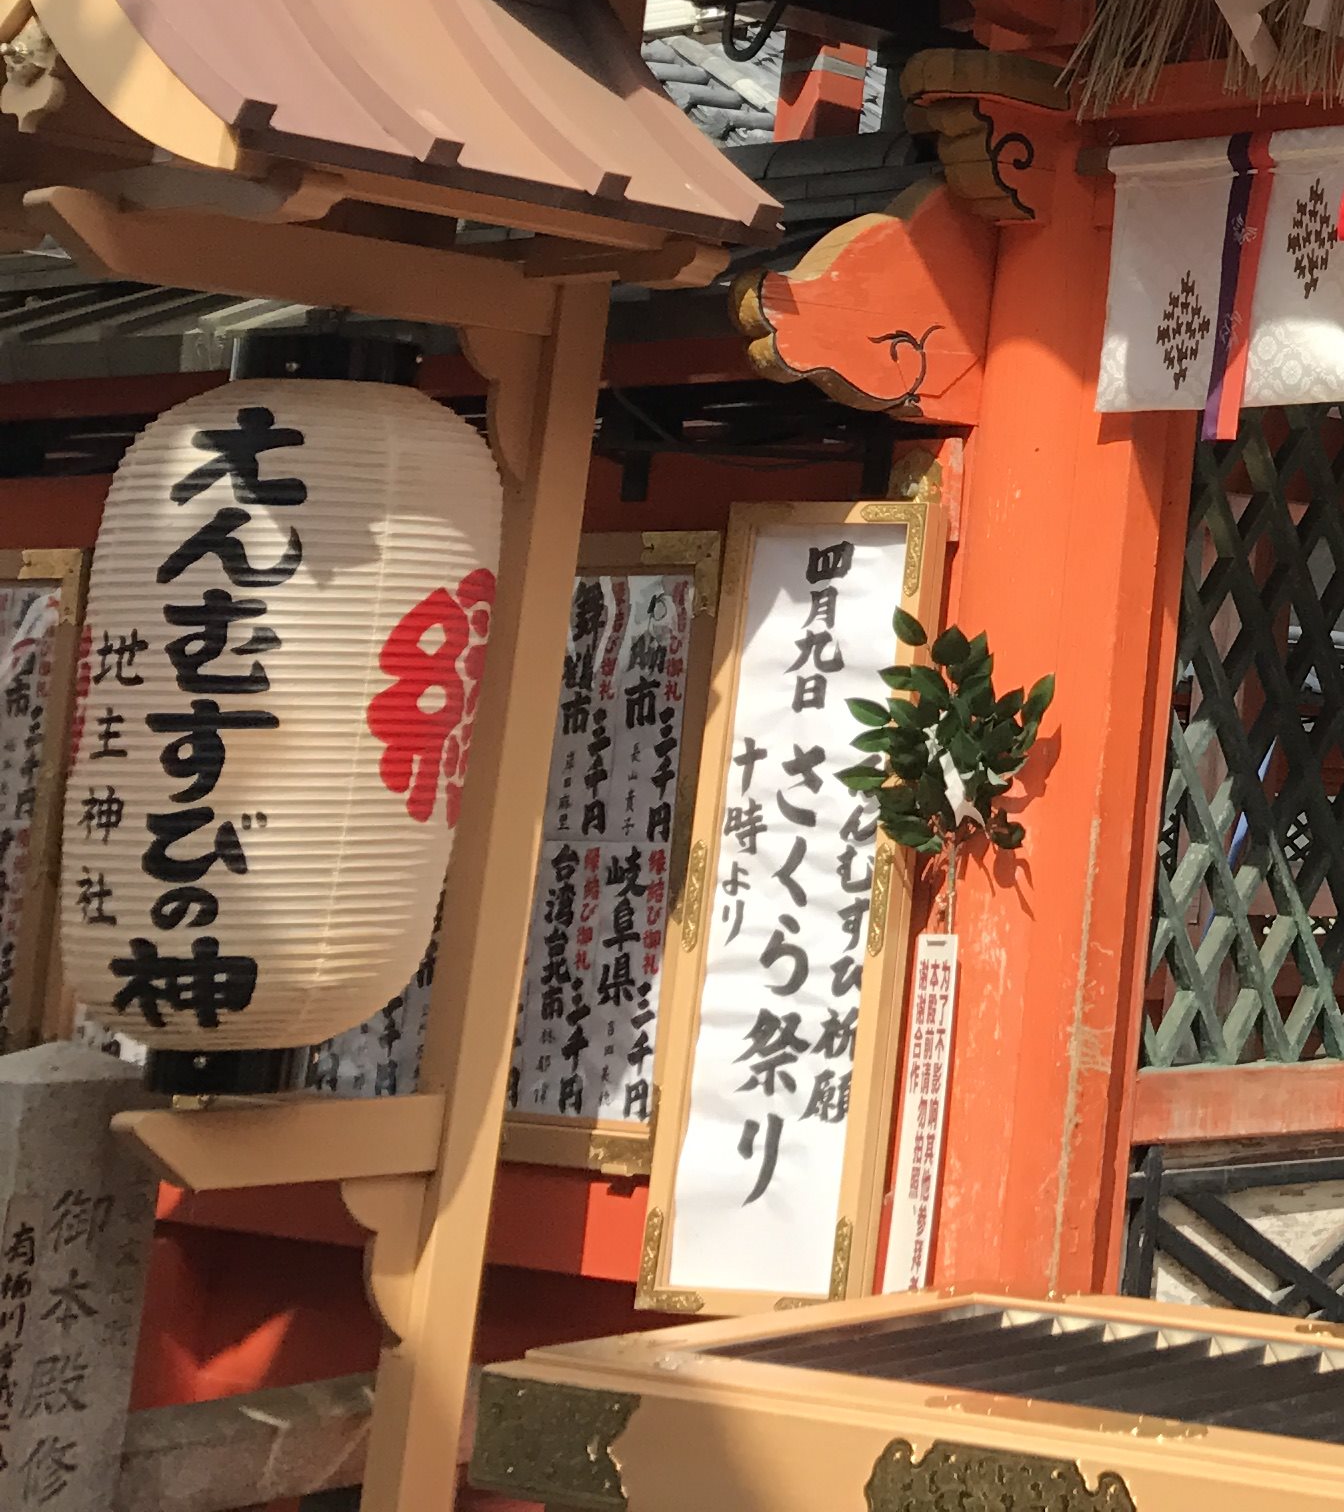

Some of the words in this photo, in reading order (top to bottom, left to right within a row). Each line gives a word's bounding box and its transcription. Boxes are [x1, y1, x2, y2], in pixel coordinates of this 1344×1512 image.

[784, 541, 855, 713] 四月九日
[75, 628, 148, 926] 地主神社
[110, 407, 308, 1027] えんむすびの神
[582, 708, 611, 835] 三千円
[647, 707, 677, 842] 三千円
[642, 849, 666, 976] 縁結び御礼
[721, 737, 768, 947] 十時より
[541, 844, 580, 1020] 台湾台北市
[598, 846, 649, 1007] 岐阜県
[732, 744, 826, 1206] さくら祭り
[559, 977, 591, 1114] 三千円
[624, 982, 655, 1121] 三千円
